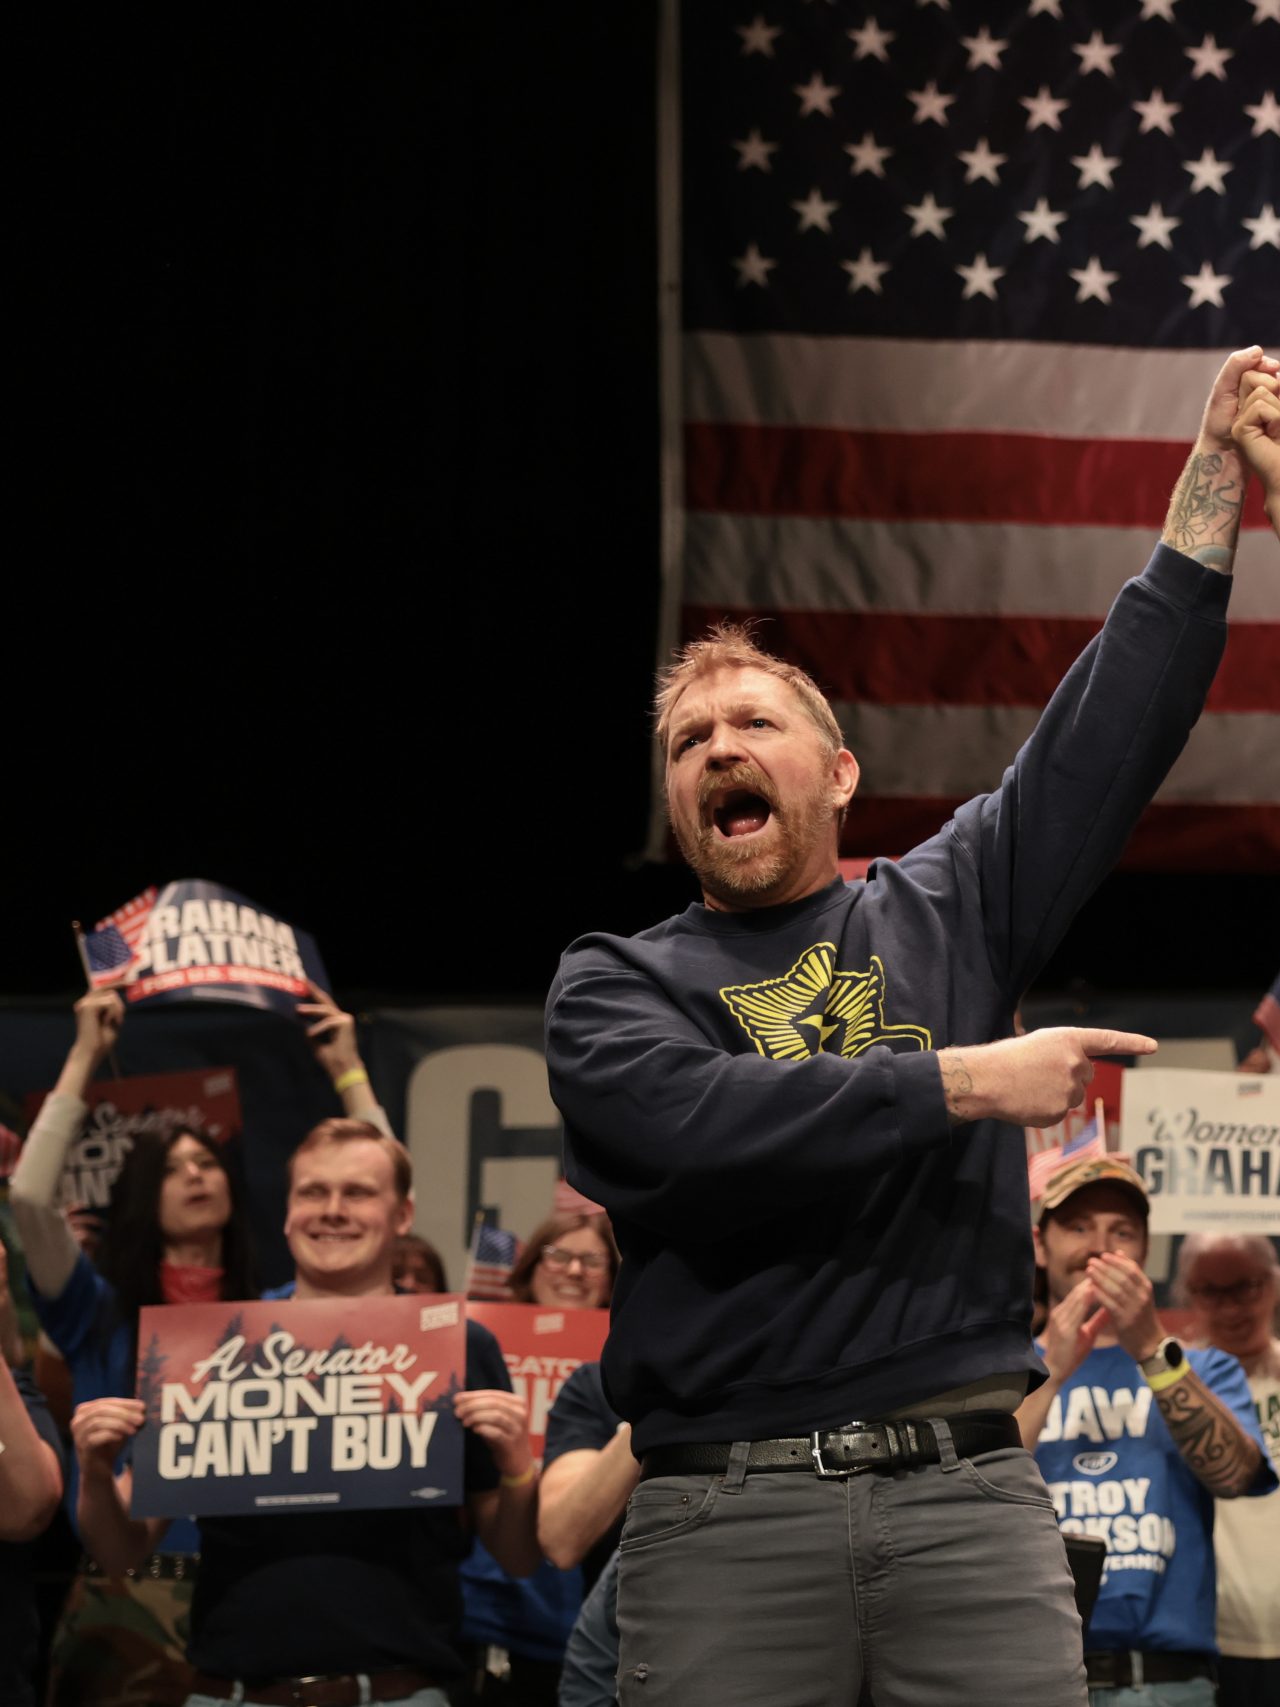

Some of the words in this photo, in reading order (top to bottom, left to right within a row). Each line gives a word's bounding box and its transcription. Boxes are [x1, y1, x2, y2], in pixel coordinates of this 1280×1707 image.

[148, 899, 299, 957] RAHAM
[190, 1335, 247, 1384] A
[252, 1331, 418, 1379] Senator
[160, 1371, 439, 1424] MONEY
[157, 1416, 319, 1481] CAN'T
[331, 1411, 439, 1473] BUY
[1047, 1477, 1151, 1519] TROY
